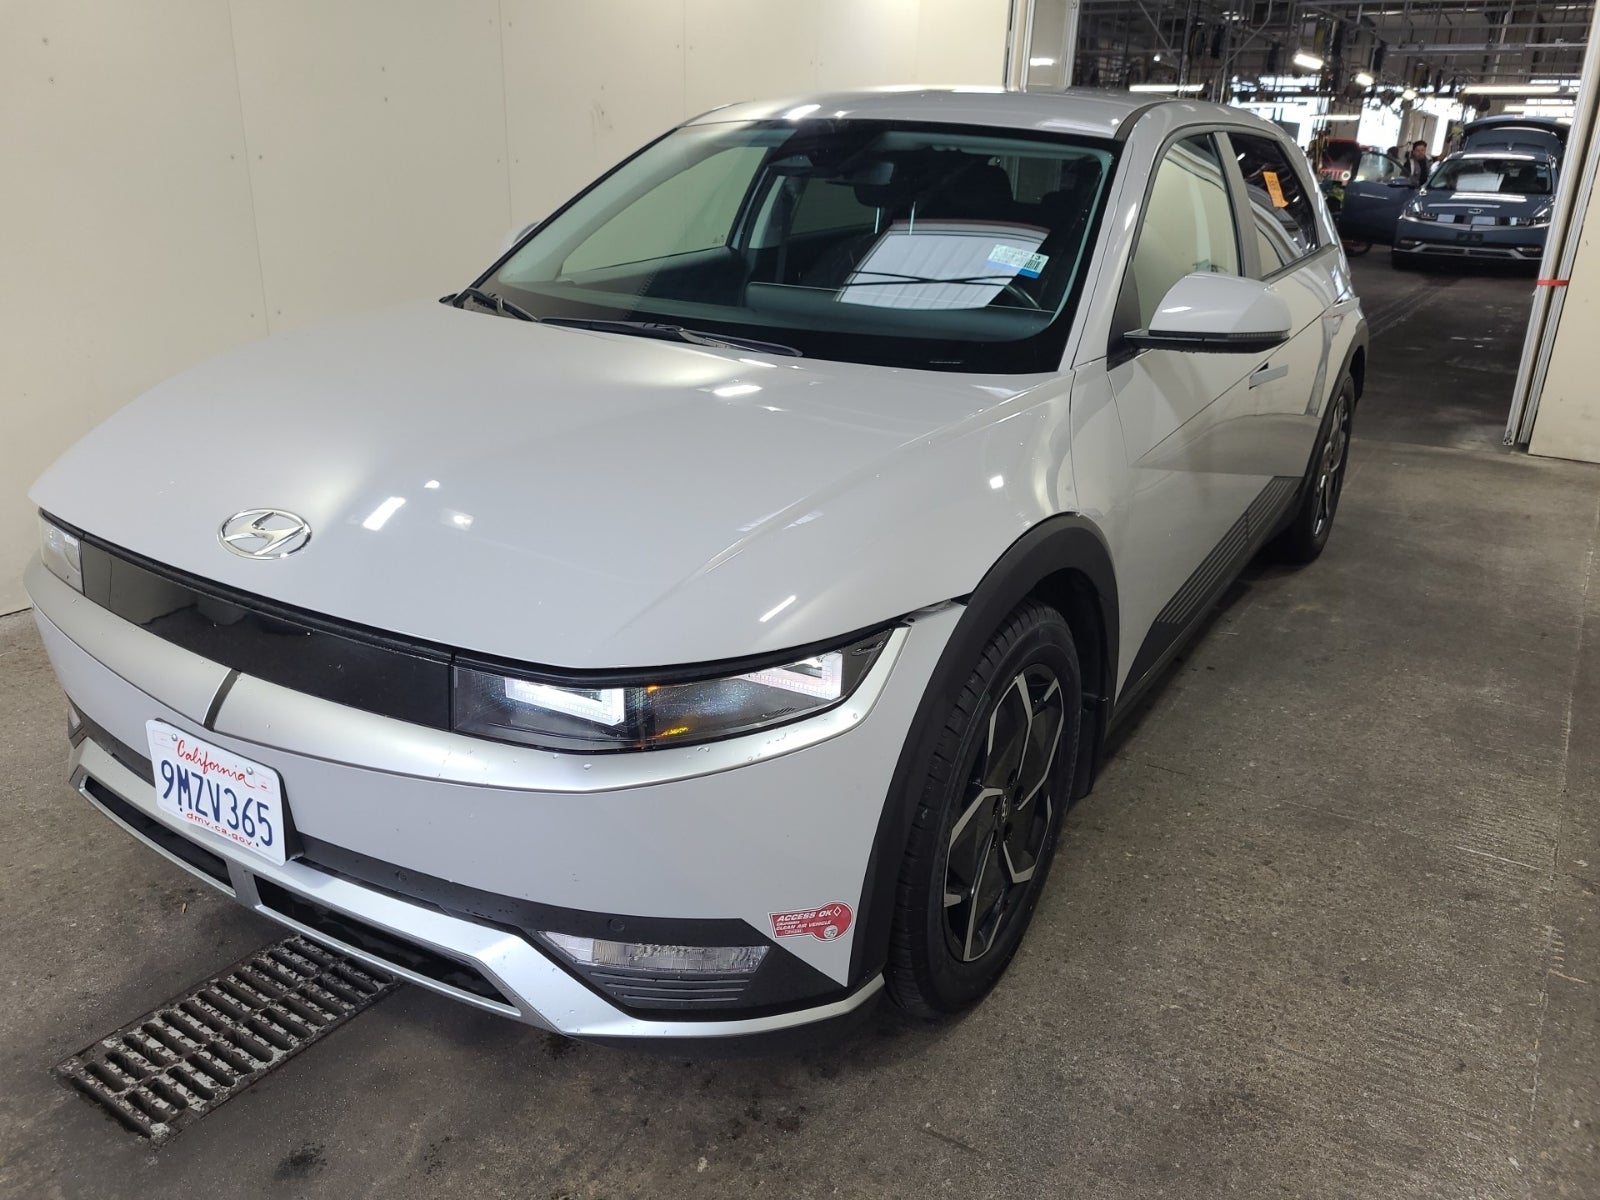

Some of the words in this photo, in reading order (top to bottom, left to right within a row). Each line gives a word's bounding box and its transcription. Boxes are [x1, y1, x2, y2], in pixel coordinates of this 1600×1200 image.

[177, 739, 255, 789] California
[160, 759, 273, 847] 9MZV365
[186, 812, 252, 846] dmv.ca.gov
[777, 912, 816, 922] ACCESS
[819, 910, 833, 918] OK
